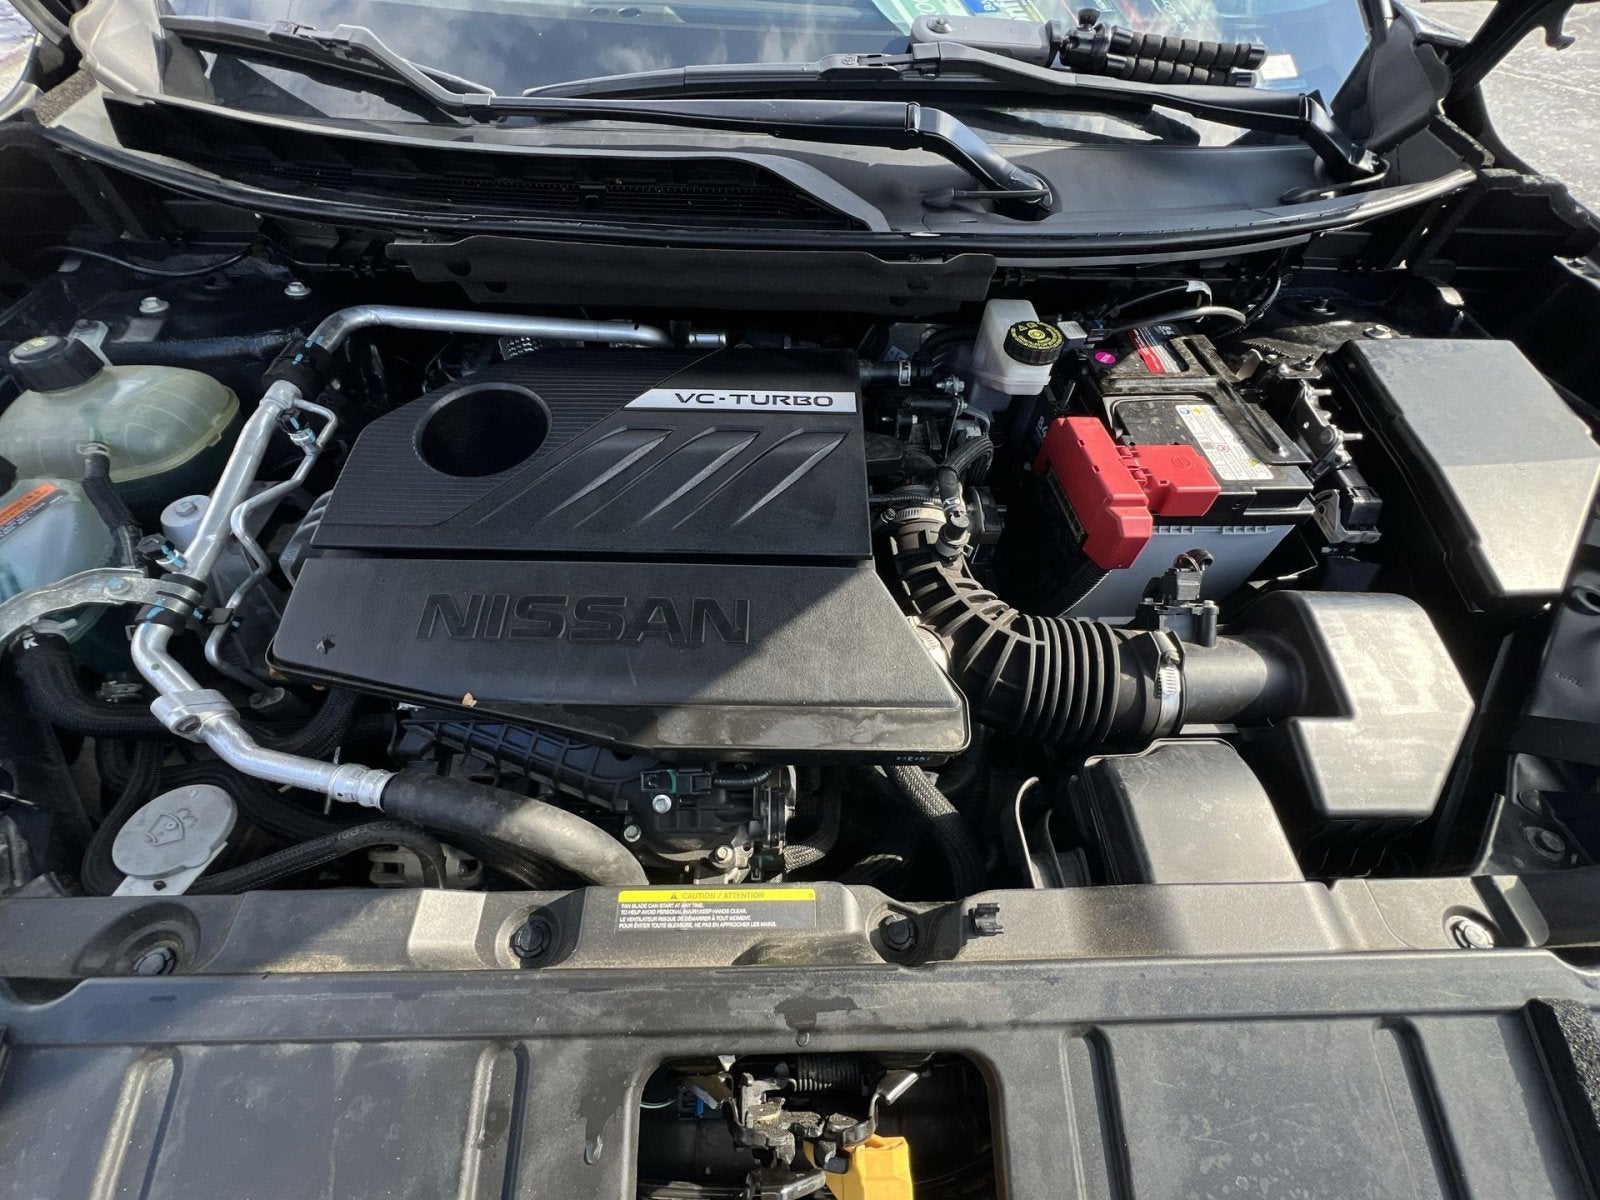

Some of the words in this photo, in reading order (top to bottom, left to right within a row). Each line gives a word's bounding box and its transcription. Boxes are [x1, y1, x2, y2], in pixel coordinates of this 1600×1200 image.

[675, 393, 833, 407] VC-TURBO
[416, 593, 750, 643] NISSAN
[682, 892, 715, 900] CAUTION
[723, 891, 764, 899] ATTENTION
